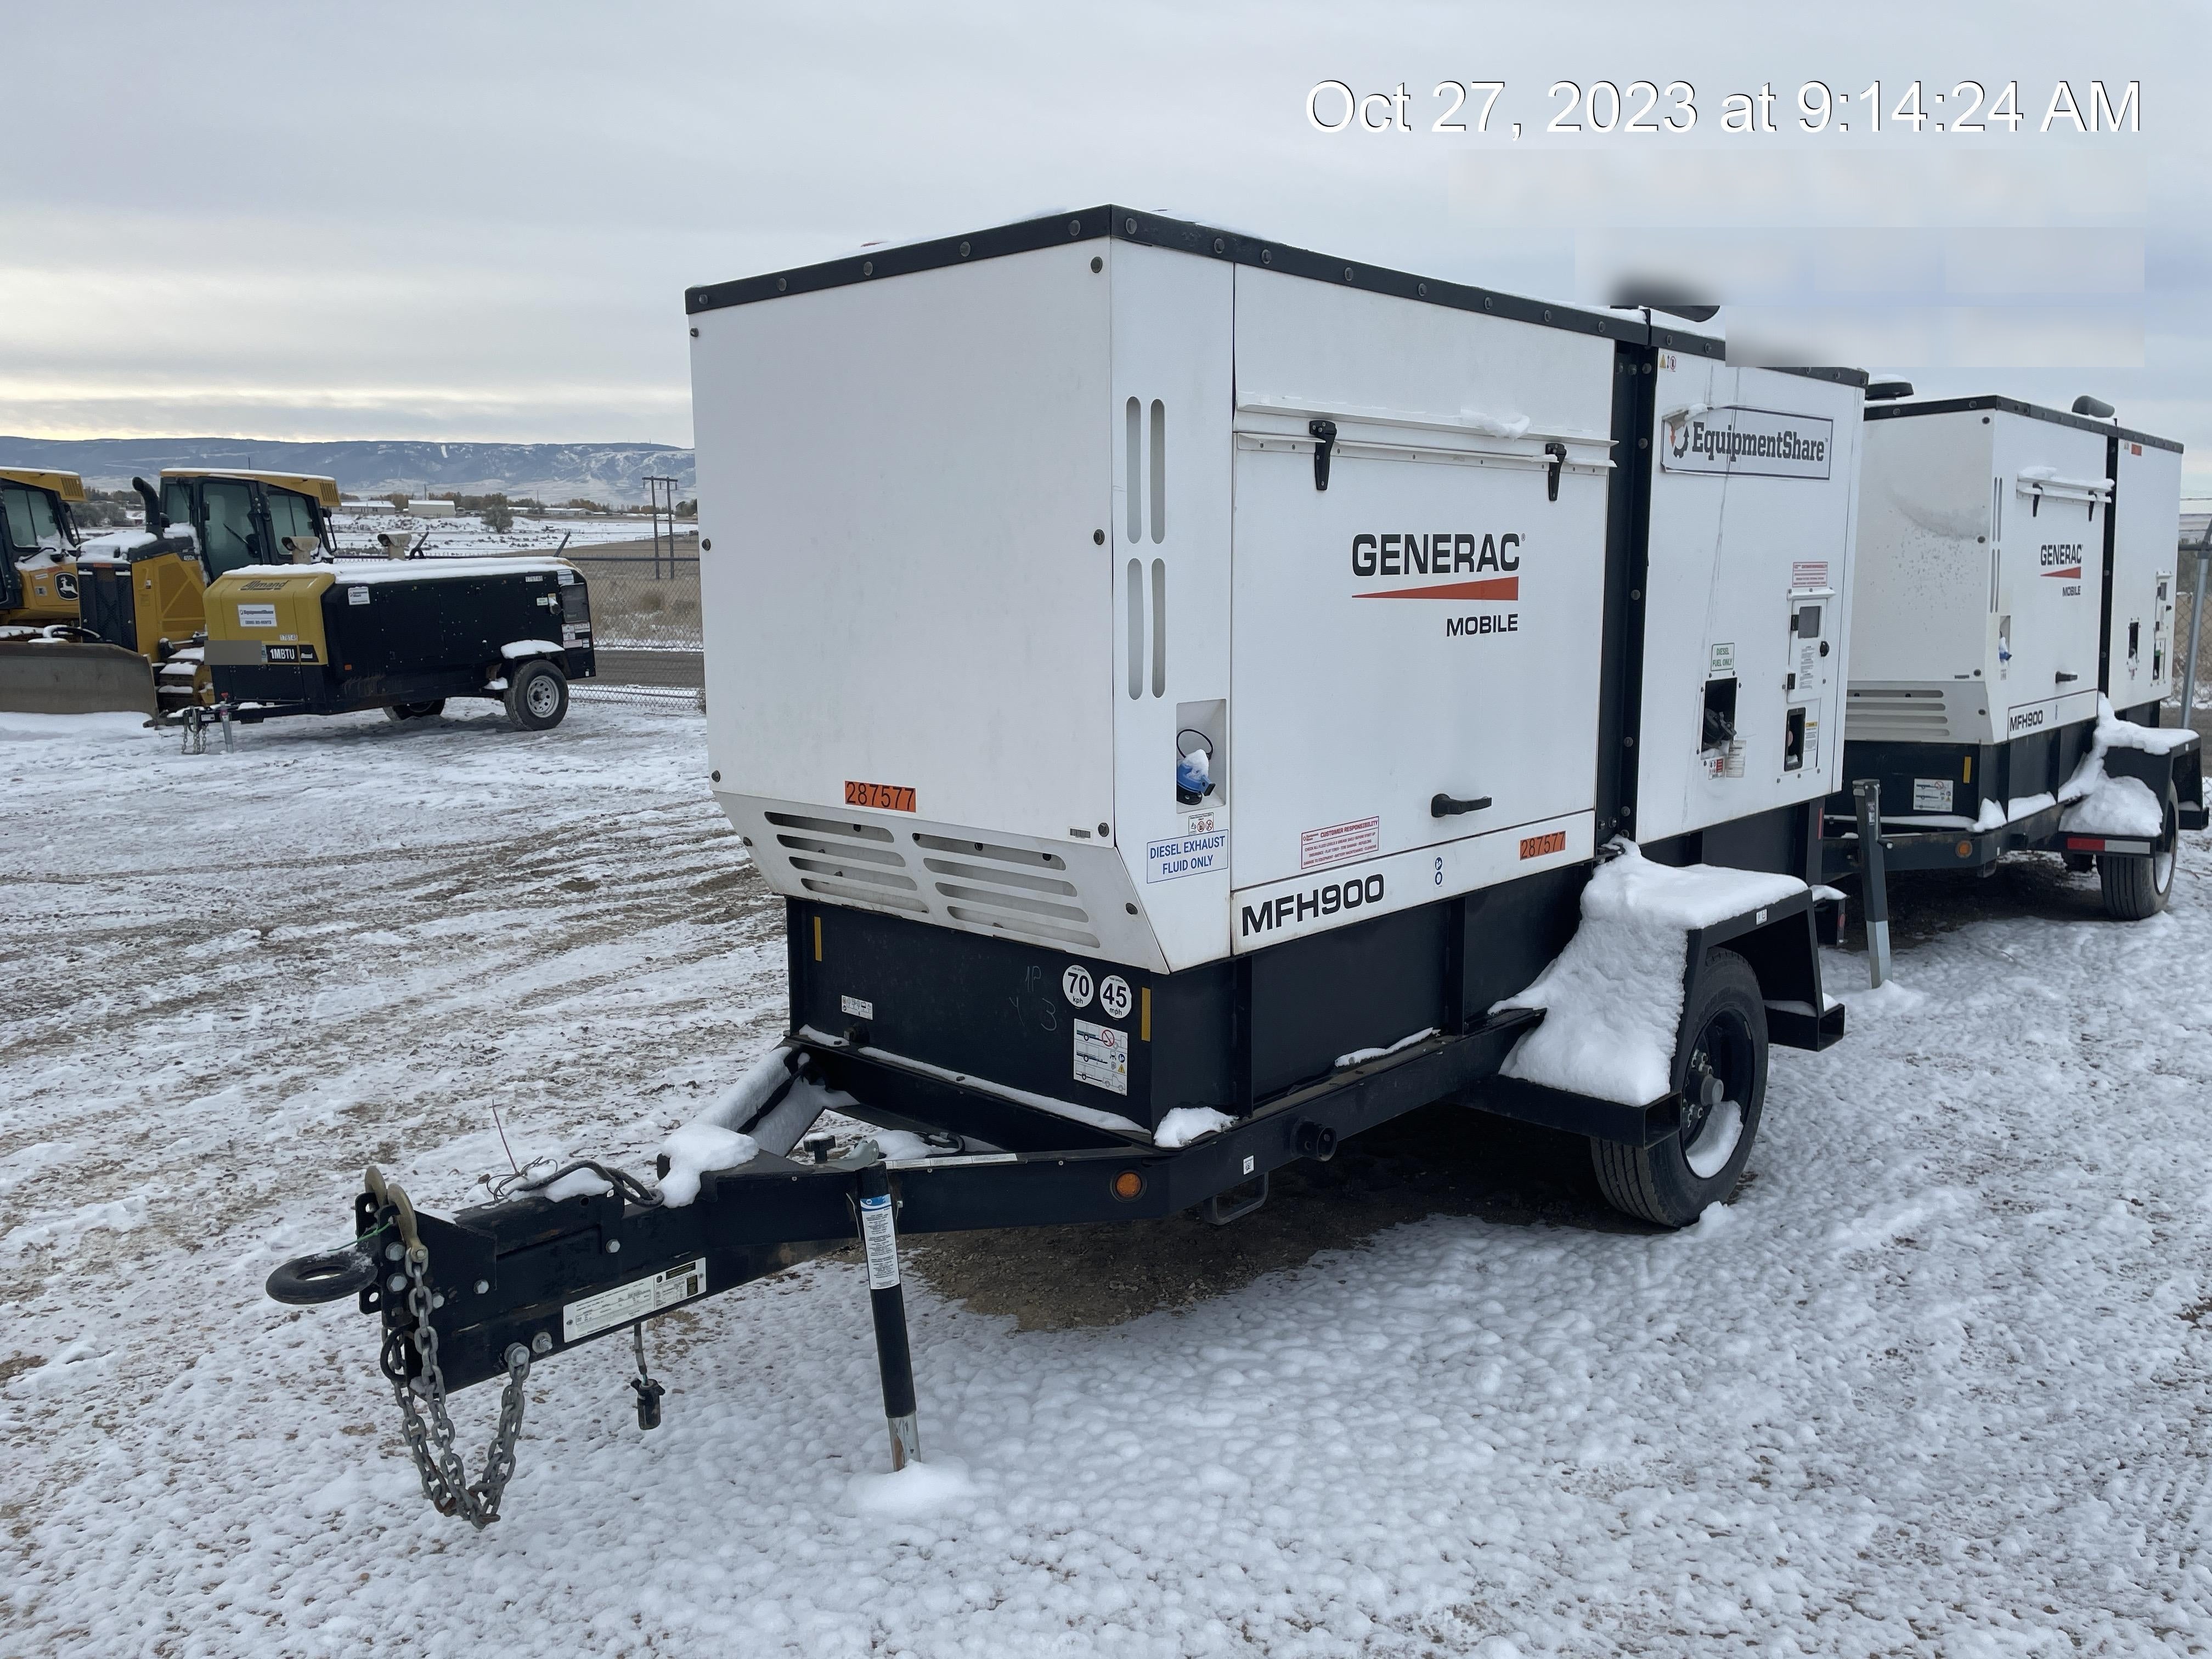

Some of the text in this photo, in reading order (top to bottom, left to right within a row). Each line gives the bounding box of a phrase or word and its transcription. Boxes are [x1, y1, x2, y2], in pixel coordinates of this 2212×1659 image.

[1692, 421, 1824, 461] EquipmentShare
[1352, 533, 1520, 576] GENERAC
[2041, 544, 2081, 566] GENERAC
[240, 579, 291, 590] Allmand
[2063, 585, 2080, 597] MOBILE
[1447, 613, 1518, 636] MOBILE
[270, 648, 295, 659] 1MBTU
[2010, 709, 2043, 731] MFH900
[847, 782, 915, 810] 287577
[1321, 820, 1378, 837] CUSTOMER RESPONSIBILITY
[1150, 836, 1226, 859] DIESEL EXHAUST
[1522, 831, 1566, 859] 287577
[1163, 855, 1214, 874] FLUID ONLY
[1242, 873, 1384, 936] MFH900
[1068, 972, 1090, 997] 70
[1103, 983, 1127, 1008] 45
[1073, 996, 1084, 1005] kph
[1109, 1008, 1122, 1016] mph
